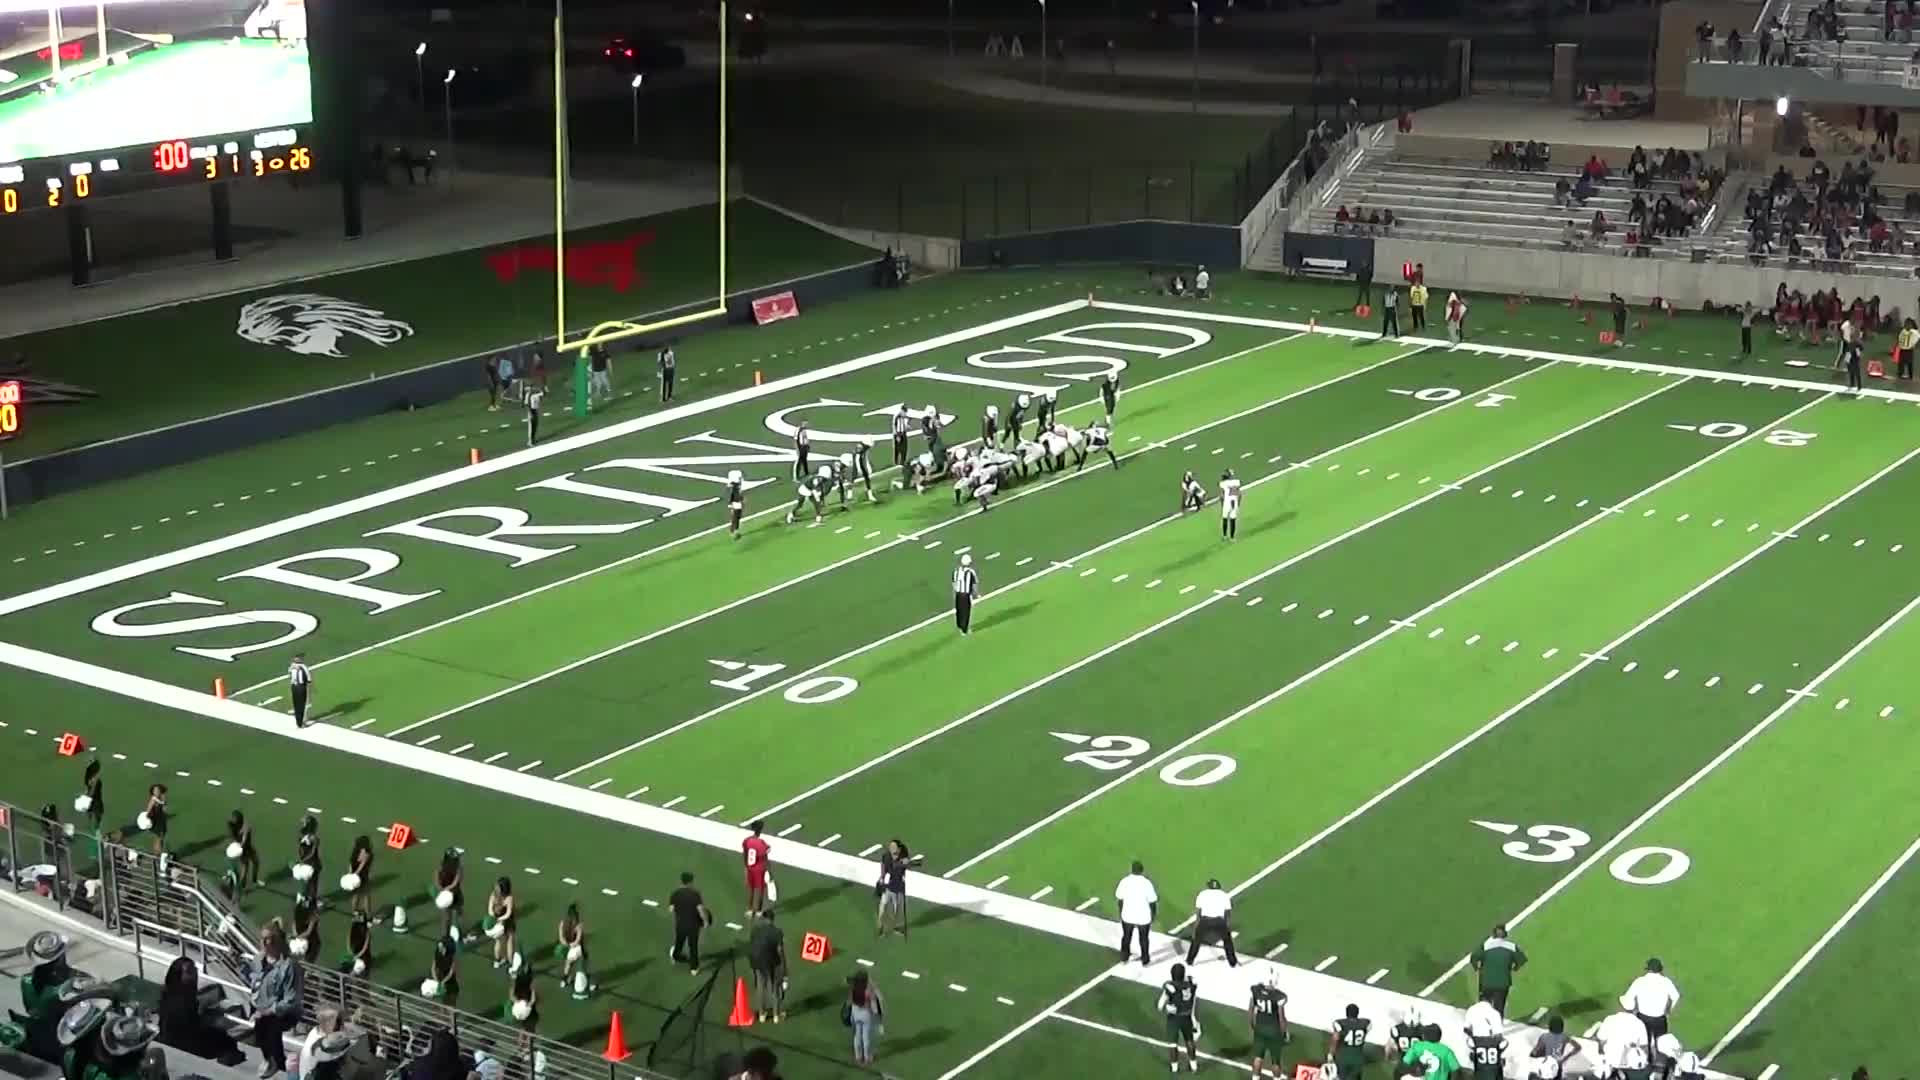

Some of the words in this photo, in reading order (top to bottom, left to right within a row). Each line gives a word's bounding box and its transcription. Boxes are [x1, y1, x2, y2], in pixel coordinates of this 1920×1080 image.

[289, 147, 311, 171] 26
[75, 173, 90, 198] 0
[91, 398, 958, 662] SPRING
[895, 320, 1213, 398] ISD
[63, 735, 74, 751] G
[391, 826, 406, 844] 10
[805, 935, 823, 957] 20
[1343, 1028, 1365, 1046] 42
[1476, 1046, 1498, 1065] 38
